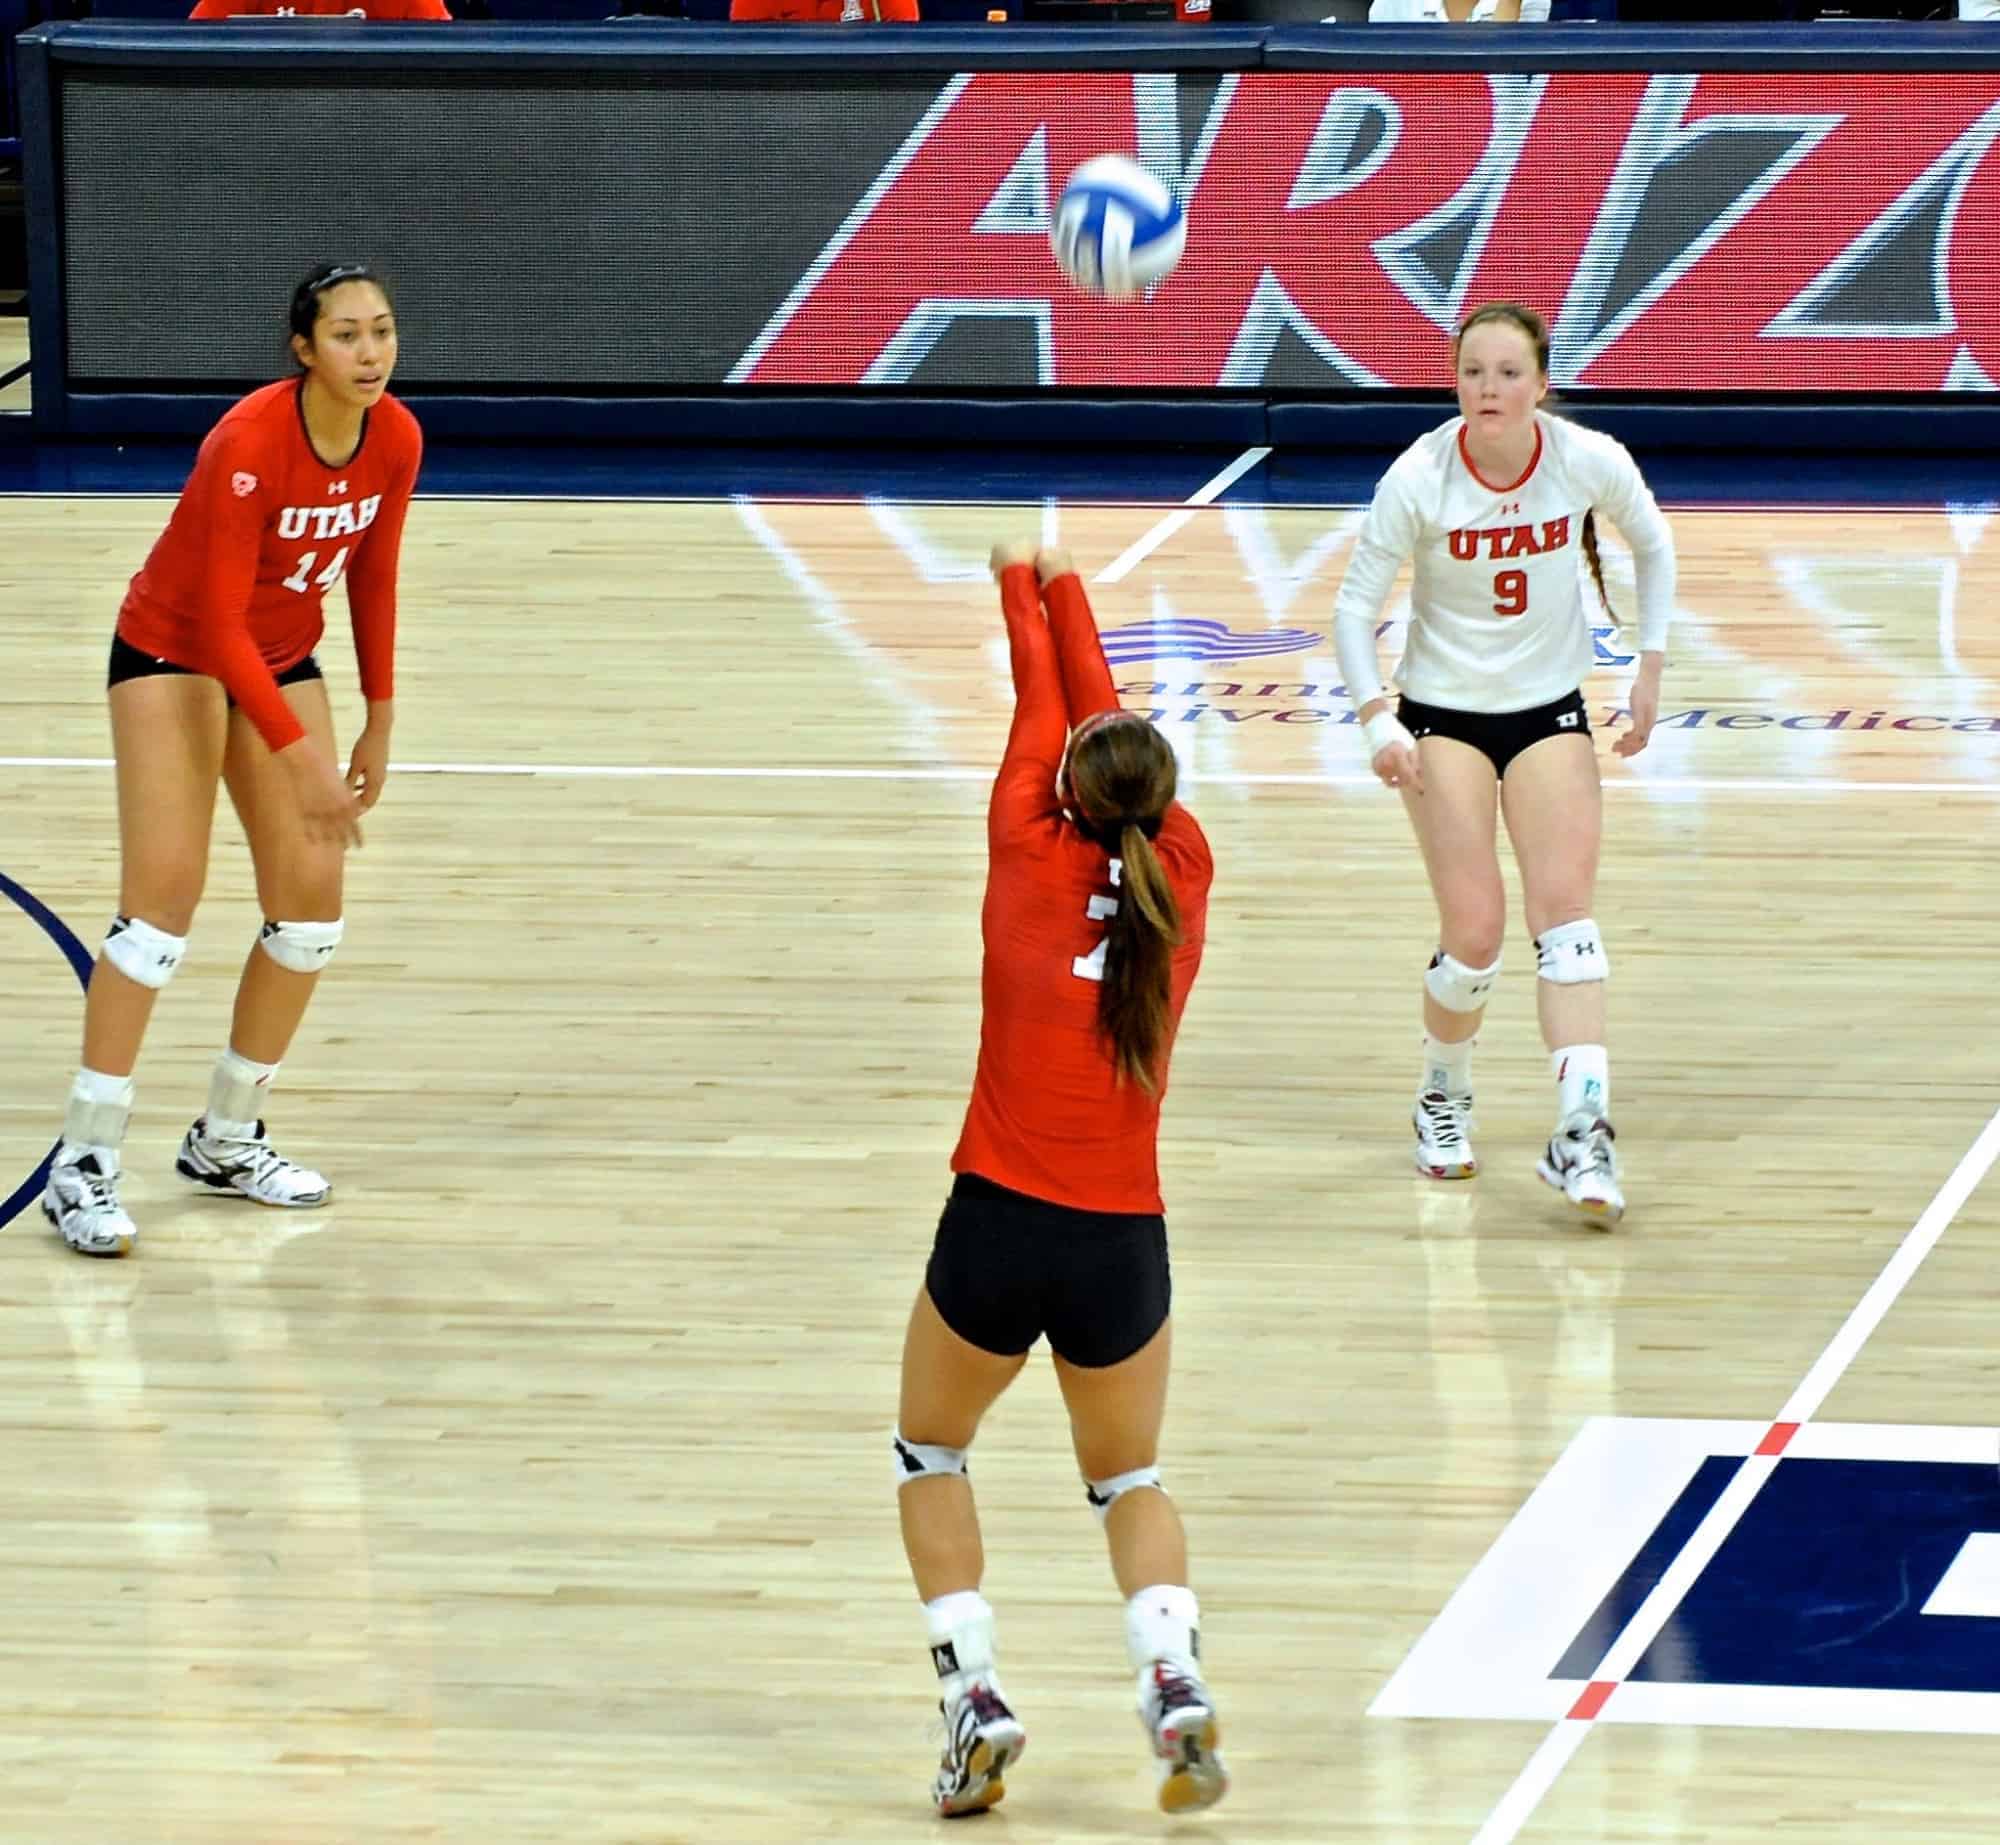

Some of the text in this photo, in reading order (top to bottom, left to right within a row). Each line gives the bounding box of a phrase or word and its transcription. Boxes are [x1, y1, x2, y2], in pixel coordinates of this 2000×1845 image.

[277, 494, 382, 540] UTAH
[1448, 515, 1570, 560] UTAH
[281, 546, 349, 593] 14
[1492, 569, 1528, 615] 9
